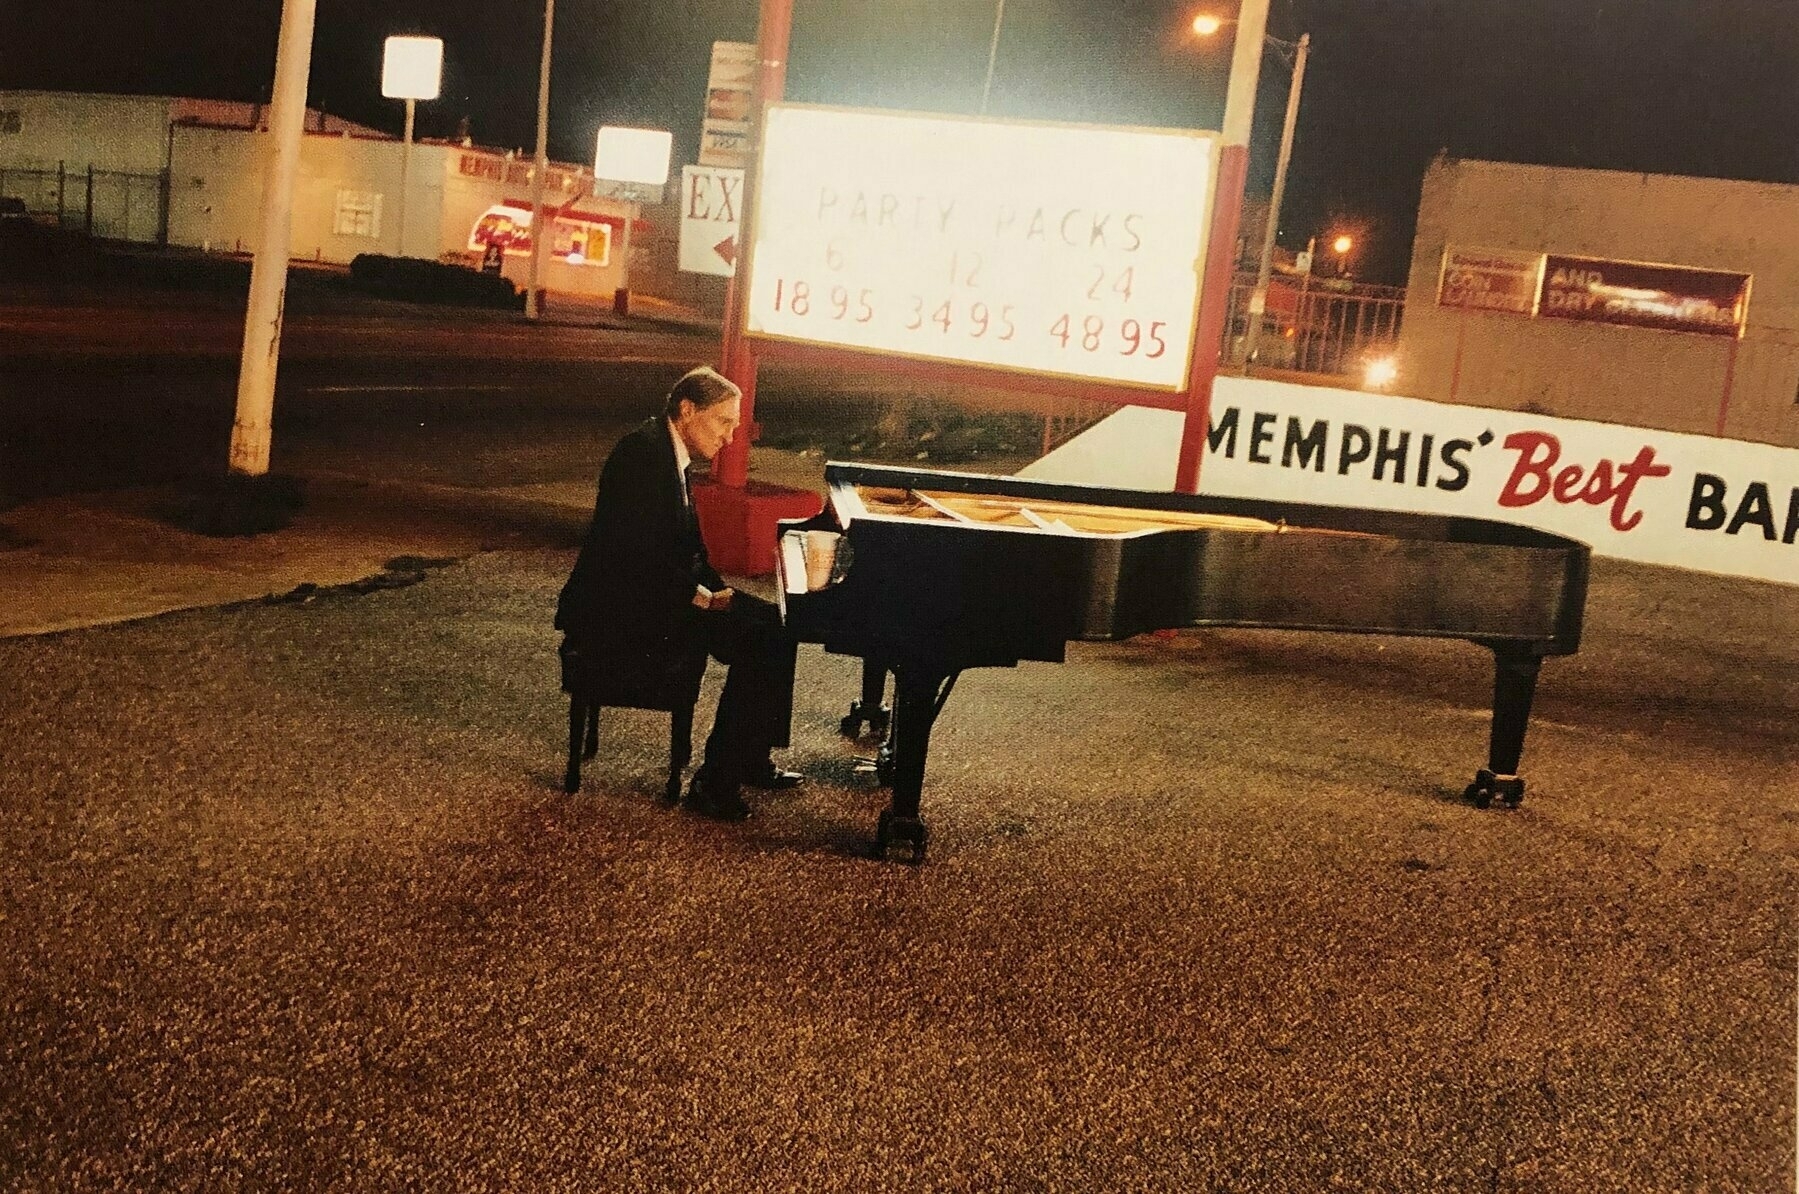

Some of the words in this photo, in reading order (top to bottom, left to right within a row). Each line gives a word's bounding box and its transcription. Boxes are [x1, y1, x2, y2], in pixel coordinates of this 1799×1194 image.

[818, 186, 956, 233] PARTY
[995, 204, 1143, 252] PACKS
[950, 250, 984, 287] 12
[1087, 264, 1135, 302] 24
[1498, 430, 1672, 532] Best
